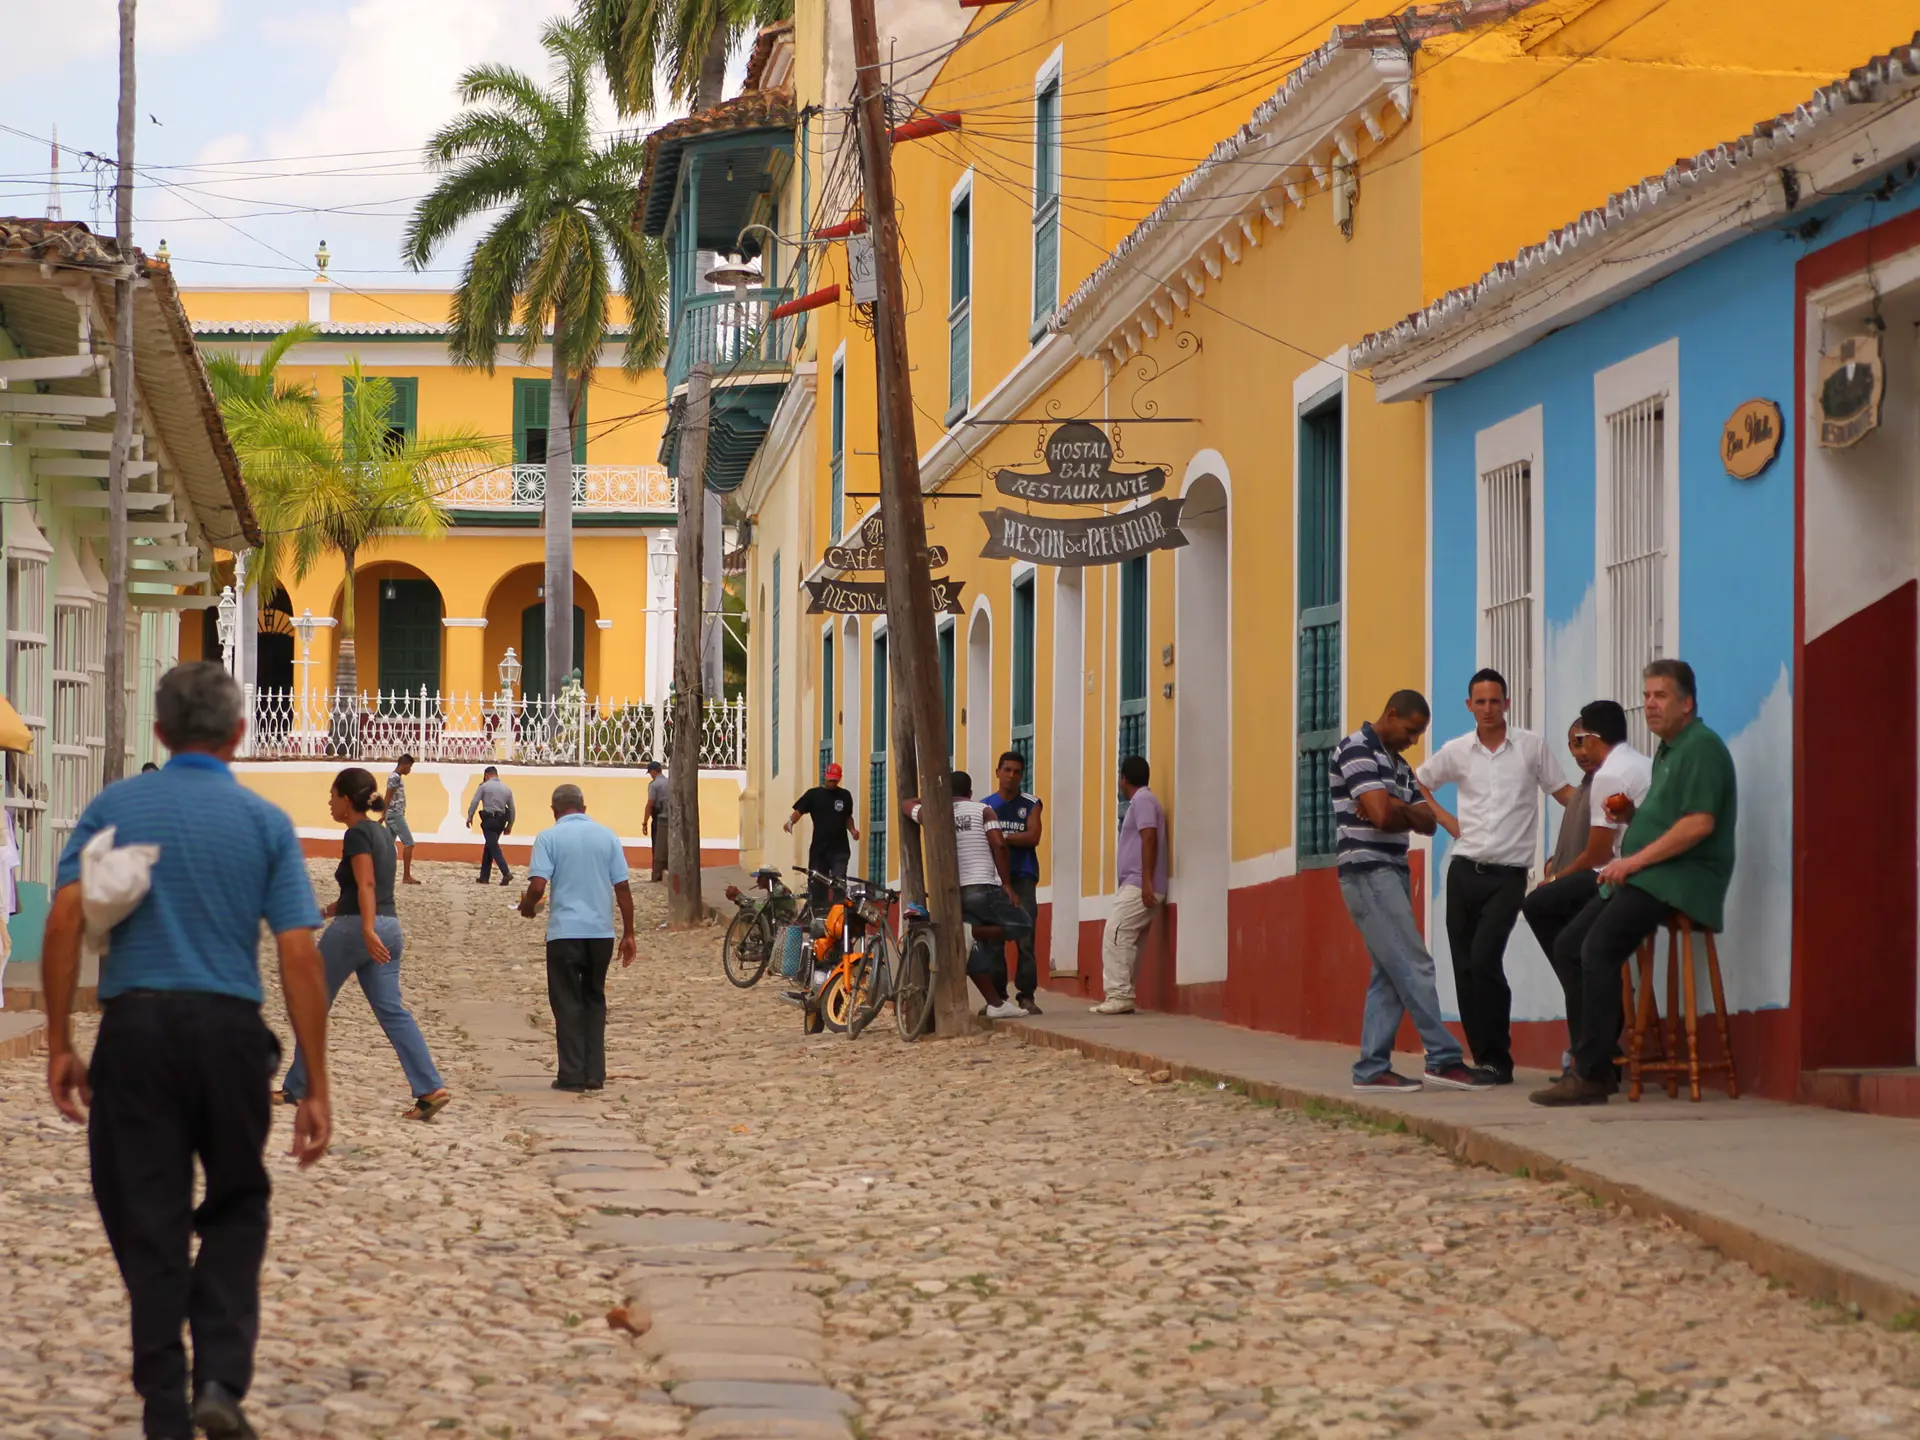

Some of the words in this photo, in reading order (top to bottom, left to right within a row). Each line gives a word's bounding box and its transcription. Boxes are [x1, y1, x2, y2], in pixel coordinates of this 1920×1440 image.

[1050, 442, 1109, 460] HOSTAL
[1059, 463, 1102, 479] BAR
[1011, 474, 1151, 500] RESTAURANTE
[1002, 517, 1067, 559] MESON
[1086, 510, 1168, 558] REGIDOR
[819, 583, 876, 611] MESON
